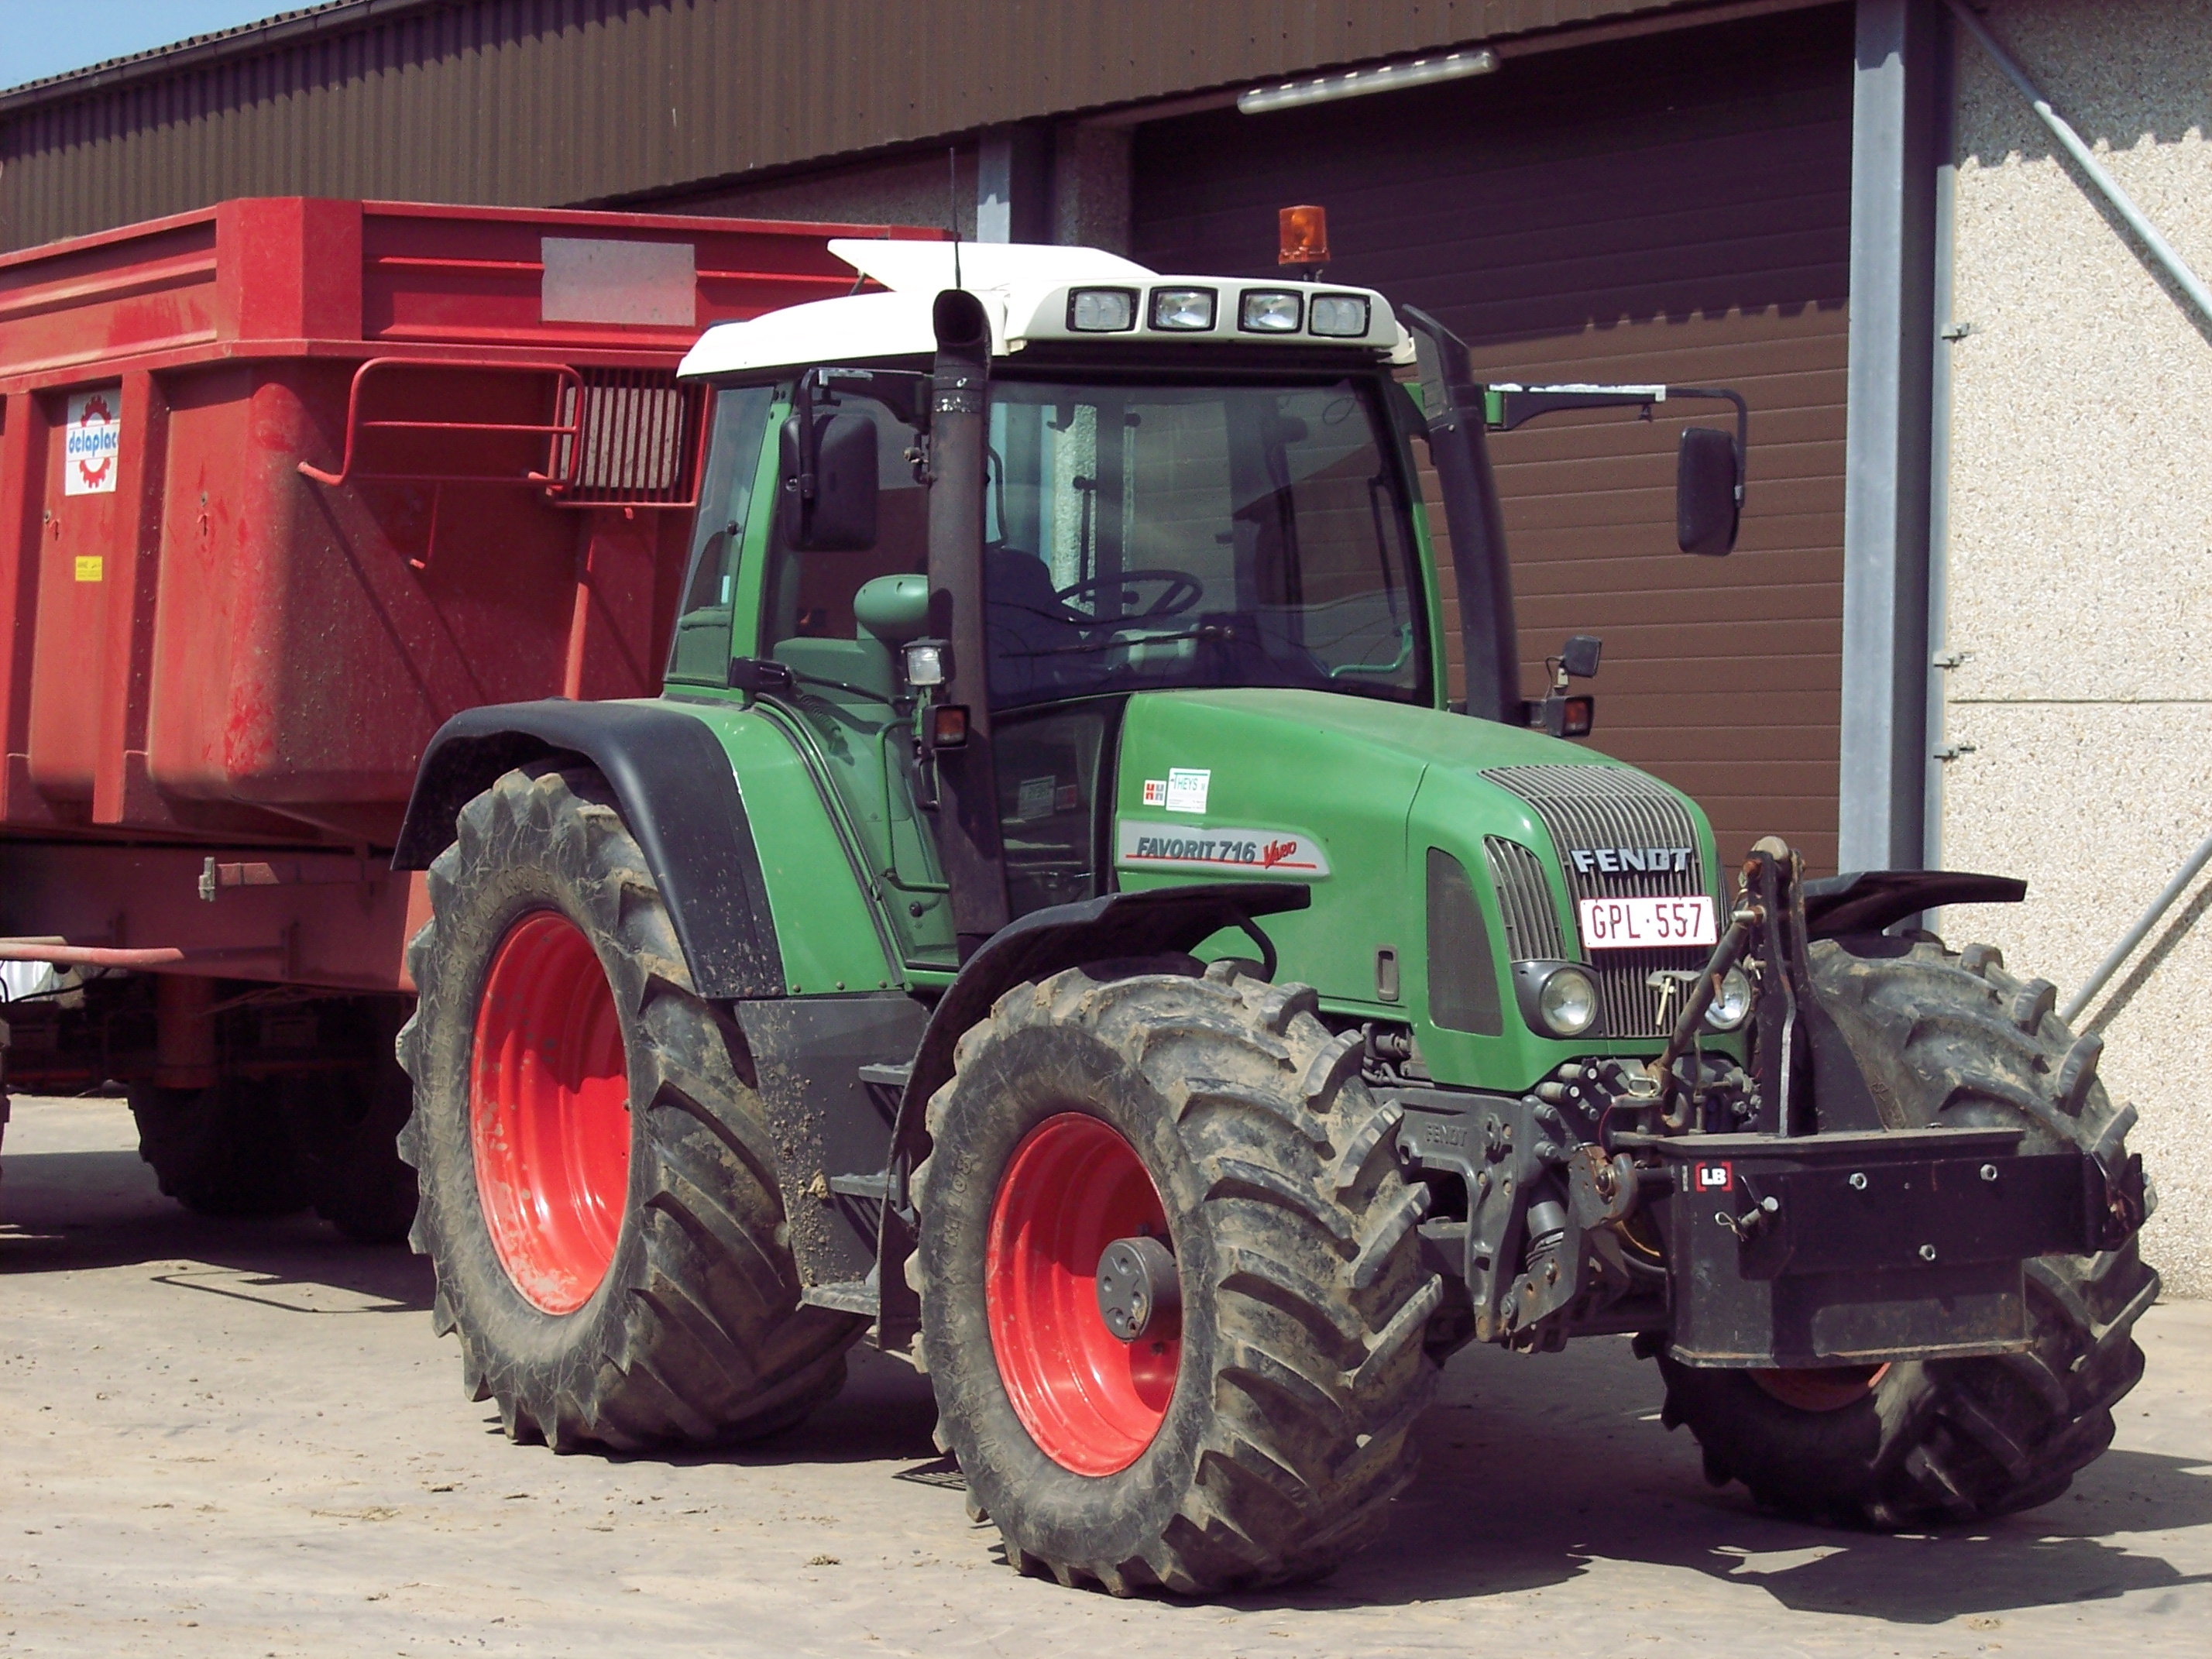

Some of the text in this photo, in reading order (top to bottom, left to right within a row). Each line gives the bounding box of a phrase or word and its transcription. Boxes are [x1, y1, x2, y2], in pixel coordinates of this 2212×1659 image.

[1136, 837, 1215, 861] FAVORIT
[1218, 841, 1256, 864] 716
[1571, 848, 1691, 873] FENDT
